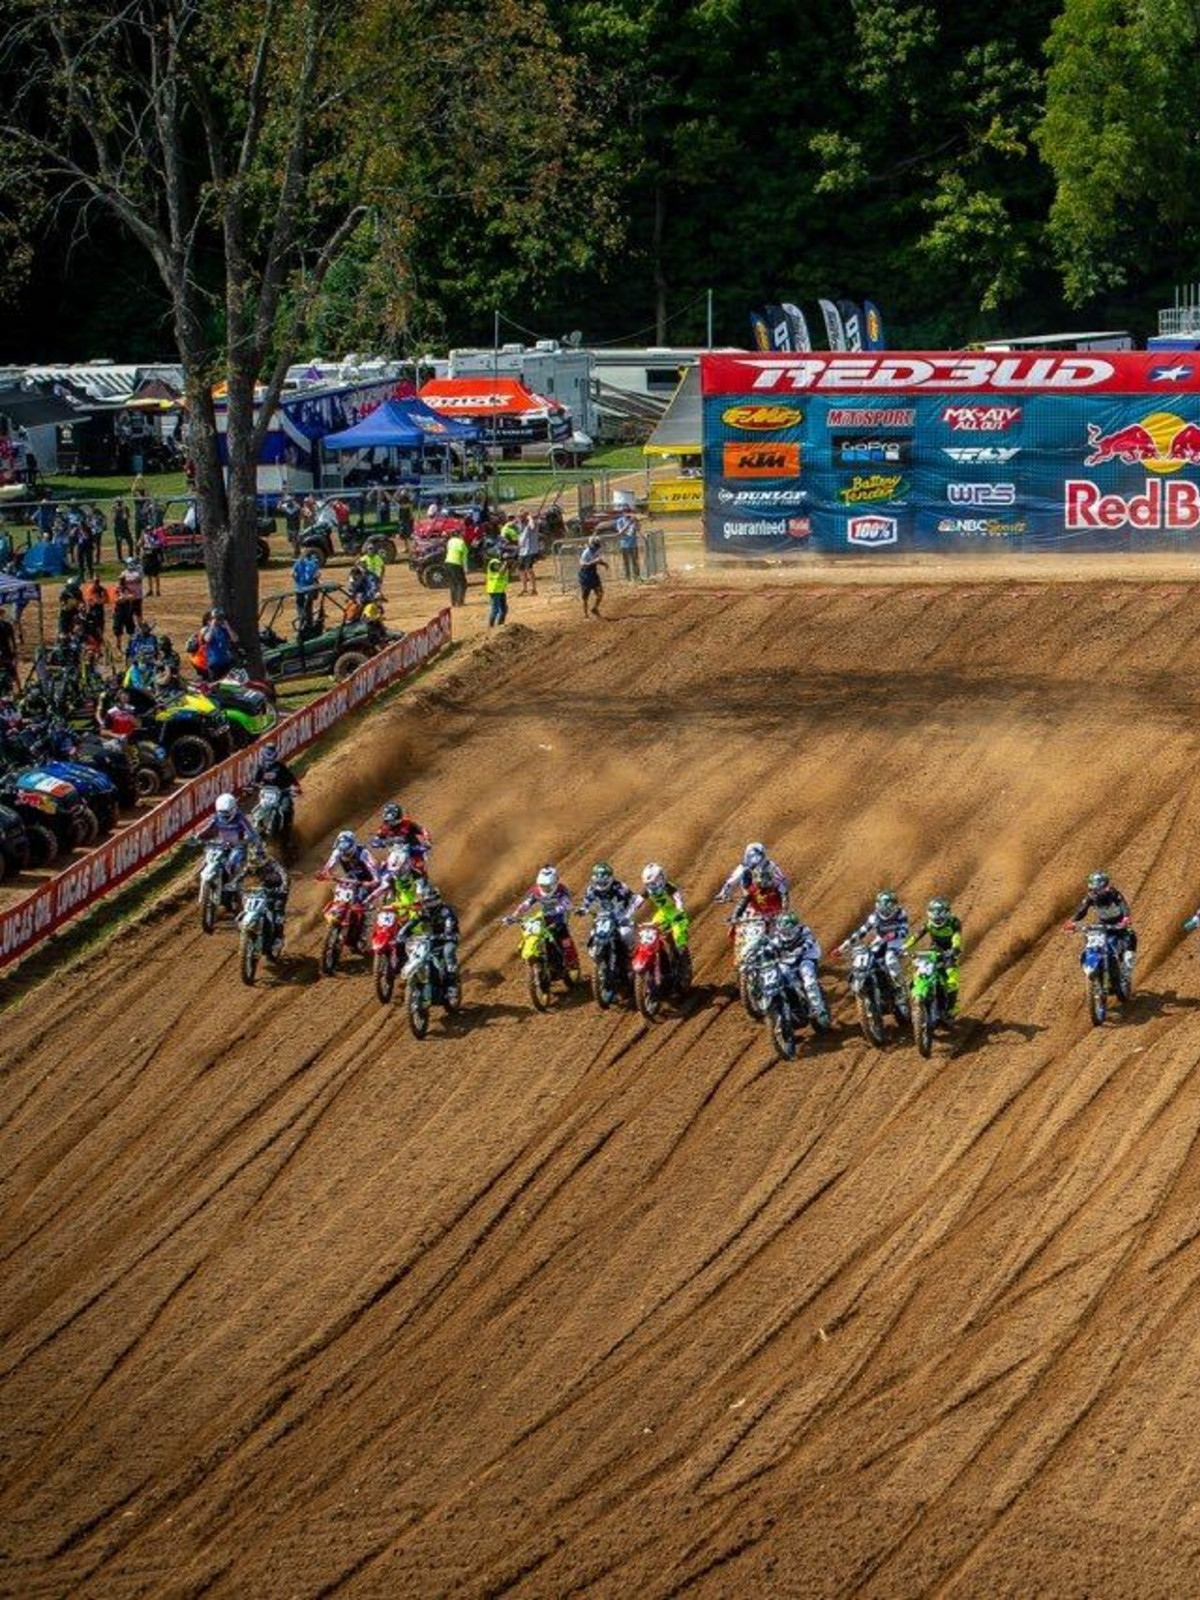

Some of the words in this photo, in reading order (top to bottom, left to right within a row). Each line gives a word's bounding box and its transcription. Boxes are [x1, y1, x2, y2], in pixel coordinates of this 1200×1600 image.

[731, 358, 1115, 388] REDBUD
[943, 408, 1022, 421] MX-ATV
[953, 421, 979, 430] ALL
[980, 421, 1005, 430] OUT
[841, 441, 901, 451] GoPro
[738, 453, 787, 469] KTM
[941, 447, 1021, 461] FLY
[852, 475, 902, 490] Battery
[733, 490, 807, 500] DUNLOP
[840, 486, 894, 504] Tender
[947, 483, 1016, 505] WPS
[1064, 478, 1161, 530] Red
[723, 519, 786, 539] guaranteed
[853, 522, 892, 539] 100%
[959, 519, 987, 532] NBC
